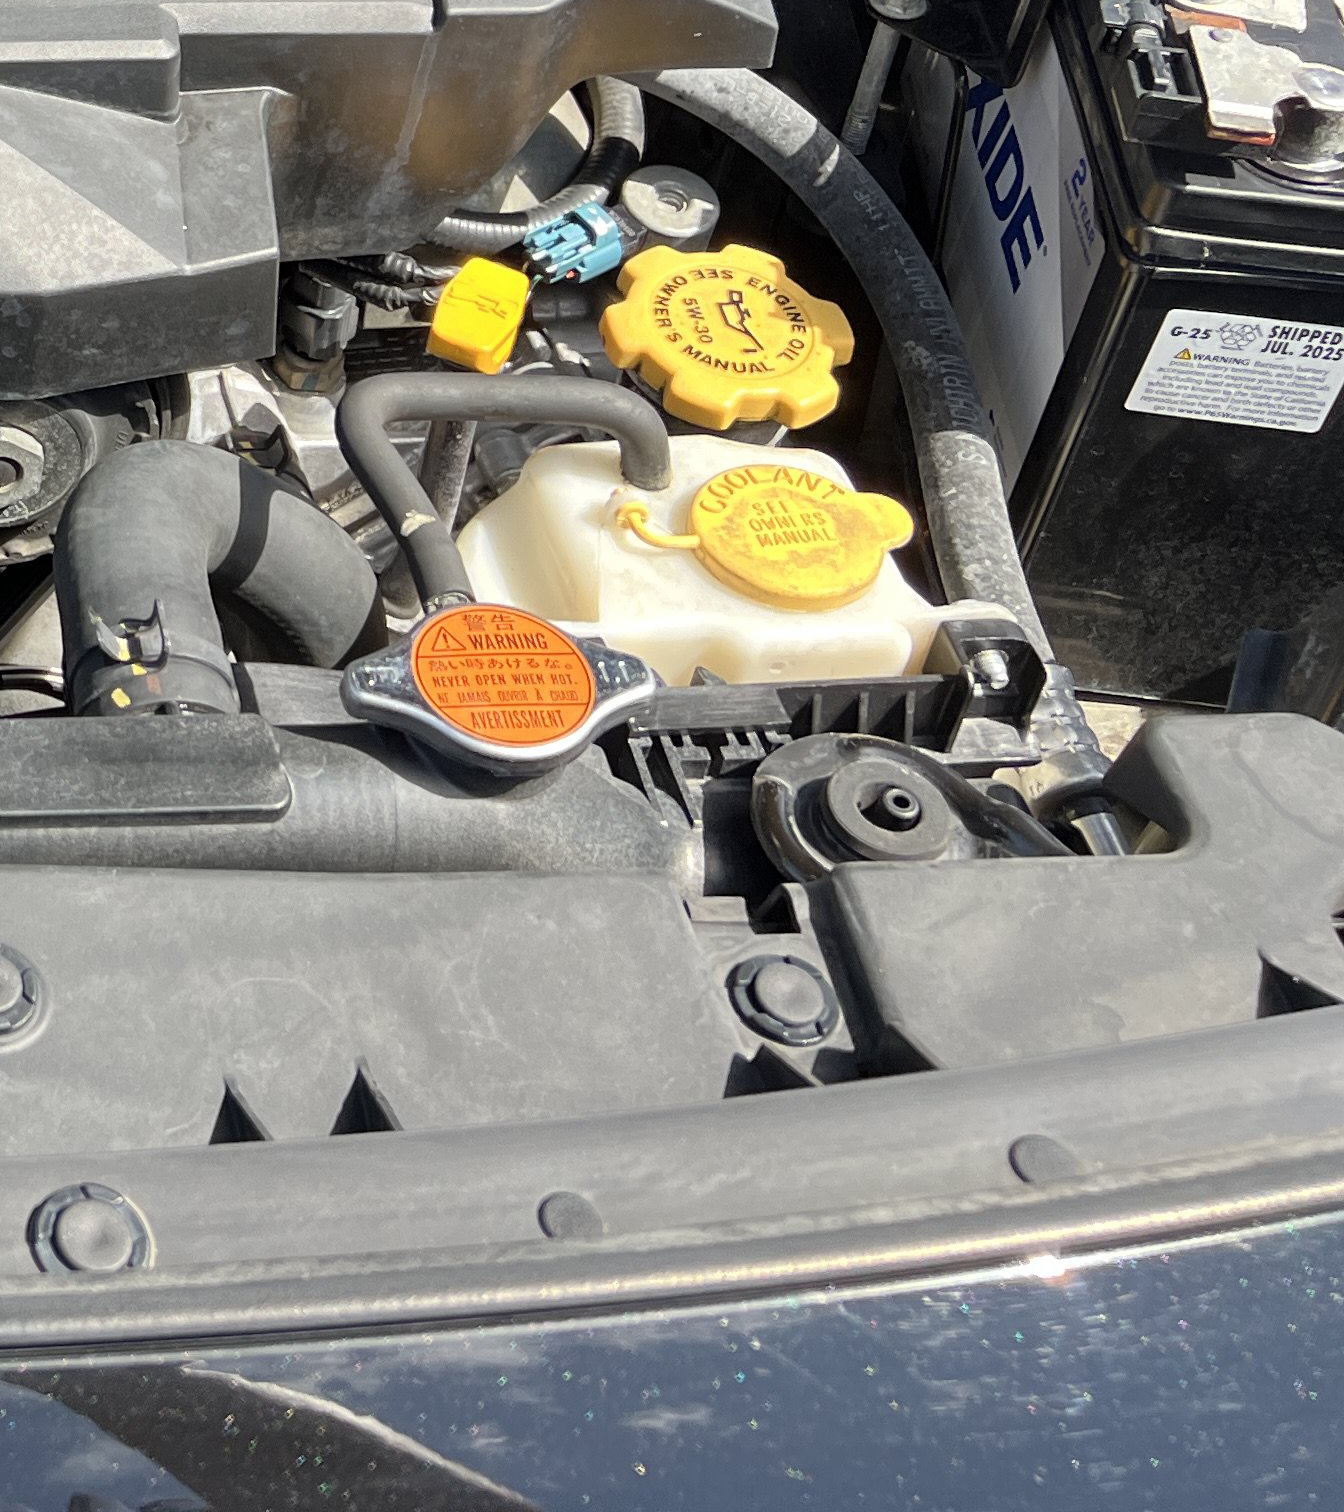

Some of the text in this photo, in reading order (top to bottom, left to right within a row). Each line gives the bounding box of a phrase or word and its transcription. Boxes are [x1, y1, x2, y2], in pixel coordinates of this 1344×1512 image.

[966, 78, 1045, 295] XIDE
[1071, 157, 1096, 248] 2 YEAR
[652, 268, 775, 374] SEE OWNER'S MANUAL
[682, 297, 714, 344] 5W-30
[746, 276, 807, 361] ENGINE OIL
[1170, 326, 1212, 340] G-25
[1267, 325, 1343, 346] SHIPPED
[1260, 340, 1344, 361] JUL. 2025
[1193, 353, 1250, 366] WARNING
[1296, 365, 1330, 377] battery
[1197, 362, 1229, 372] battery
[1162, 375, 1203, 386] including
[1204, 378, 1225, 387] lead
[1223, 374, 1257, 383] expose
[1147, 380, 1174, 388] which
[1191, 386, 1222, 394] known
[1250, 392, 1273, 400] State
[1284, 396, 1326, 407] California
[1181, 392, 1211, 400] cancer
[1230, 397, 1252, 406] birth
[1253, 401, 1285, 409] defects
[1297, 406, 1322, 414] other
[1140, 395, 1196, 406] reproductive
[1267, 410, 1319, 421] information
[699, 467, 845, 514] COOLANT
[751, 500, 788, 516] SEE
[755, 527, 837, 548] MANUAL
[462, 613, 515, 632] 警告
[467, 632, 549, 651] WARNING
[431, 673, 579, 688] NEVER OPEN WHEN HOT.
[458, 691, 491, 704] JAMAIS
[470, 709, 566, 730] AVERTISSMENT
